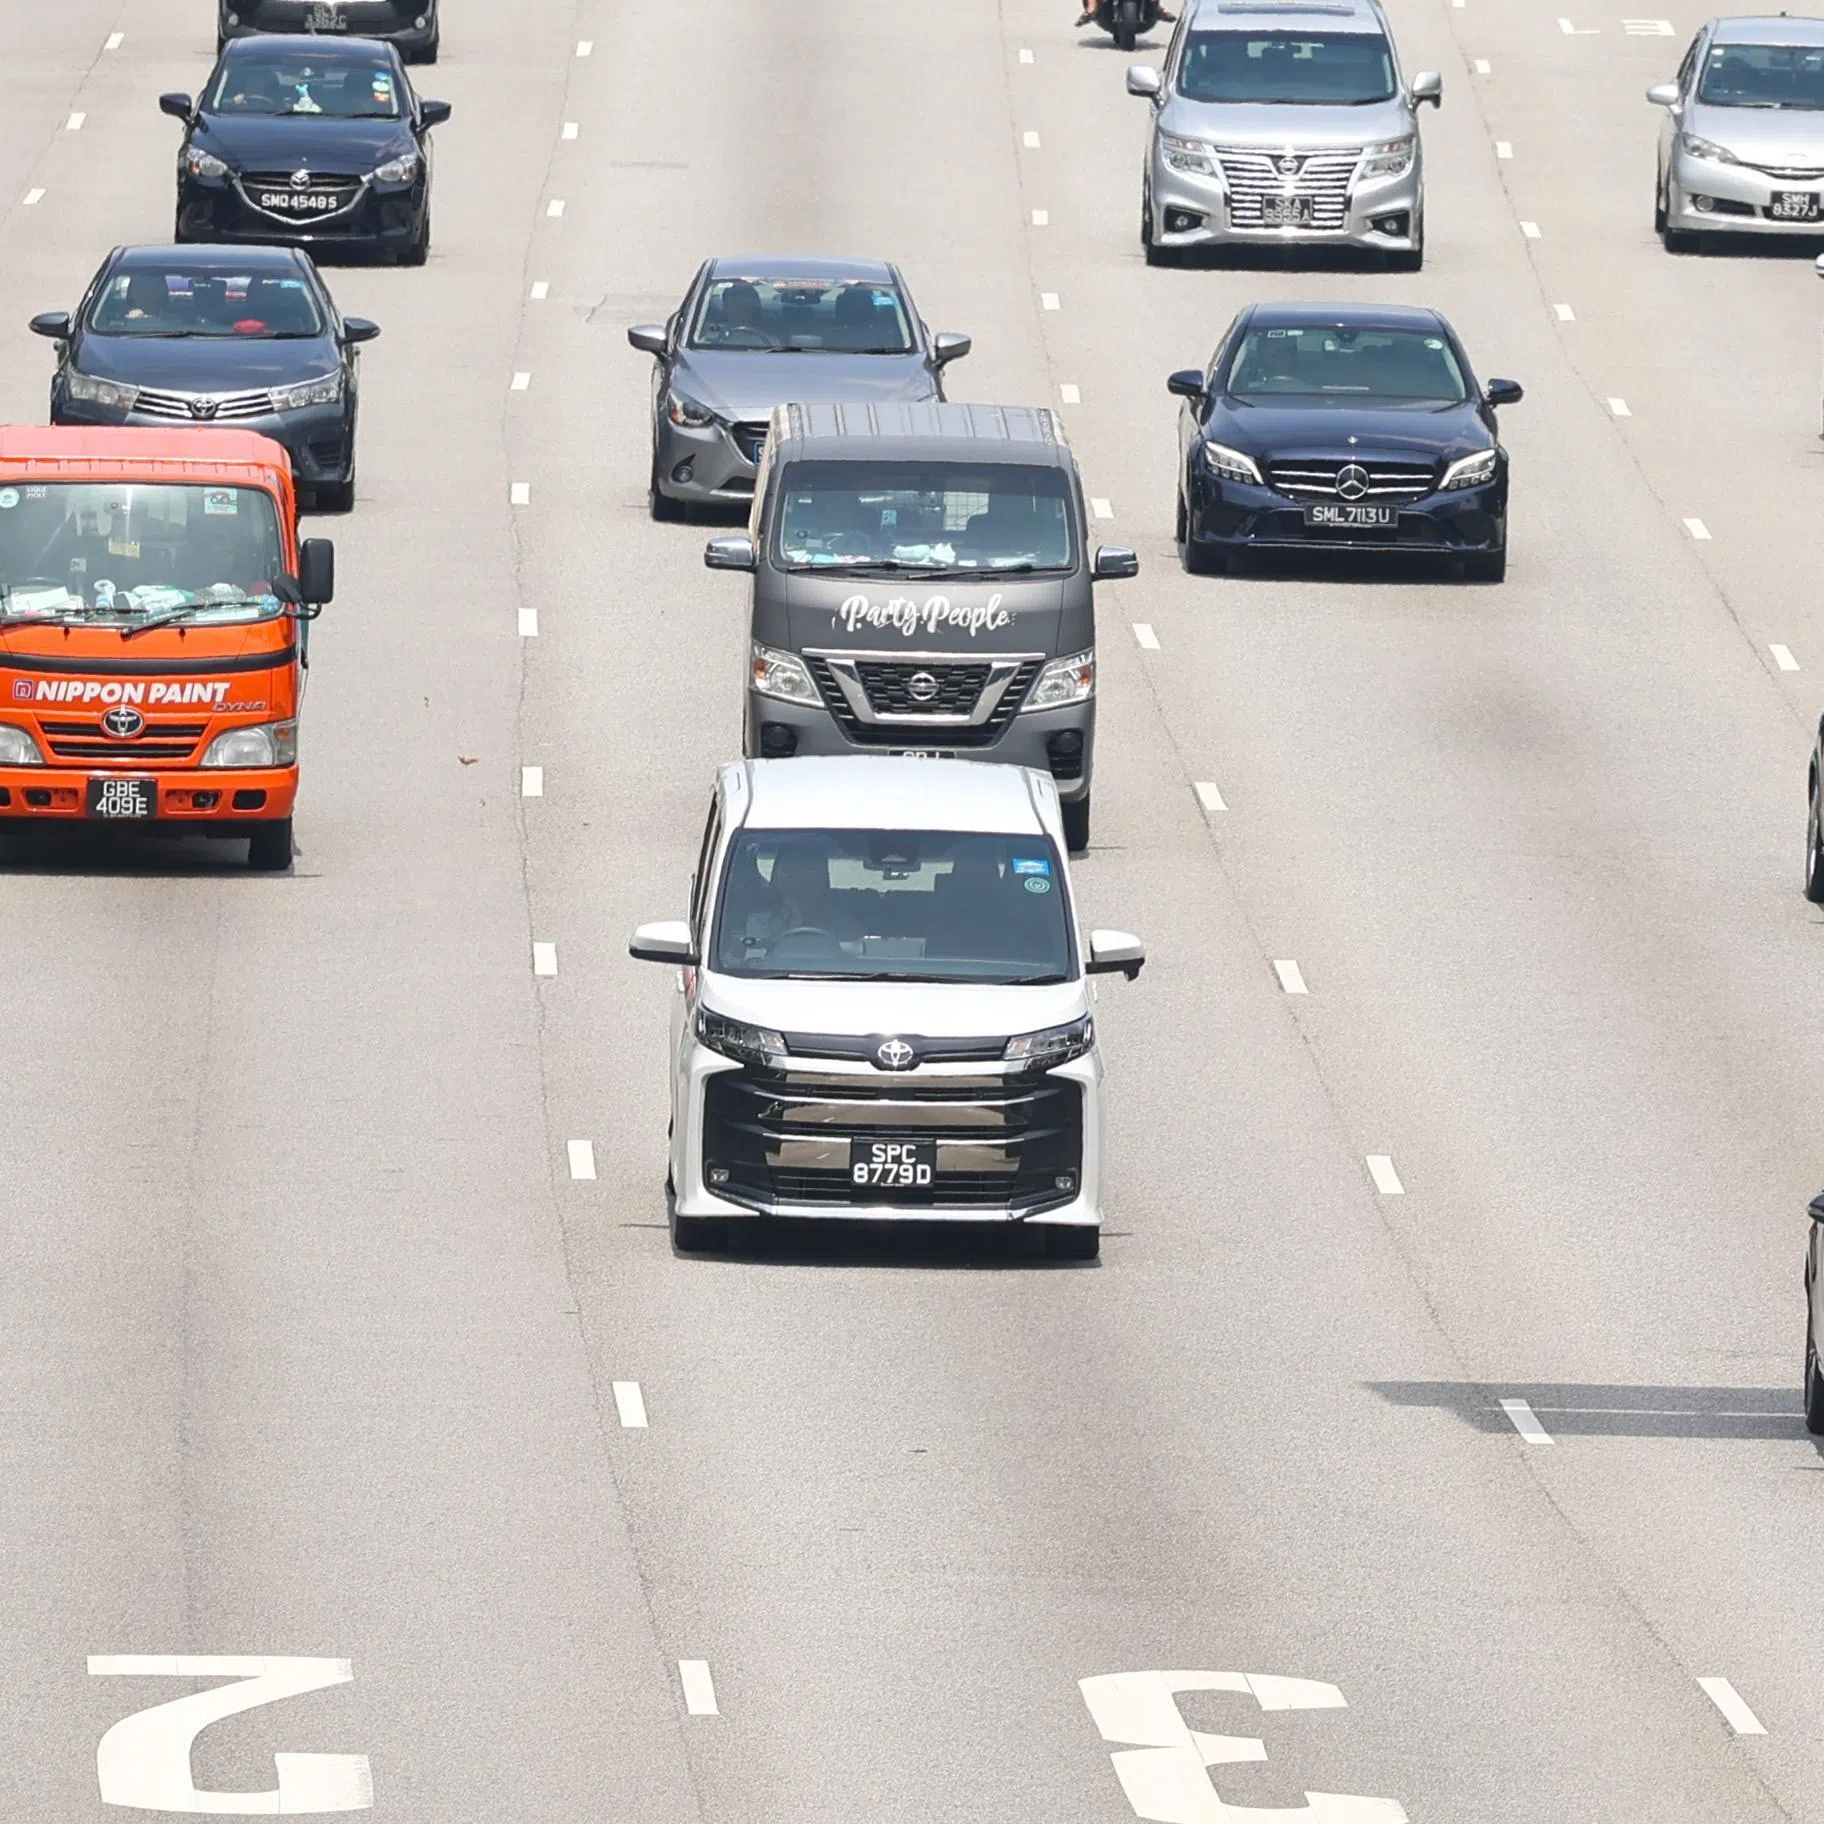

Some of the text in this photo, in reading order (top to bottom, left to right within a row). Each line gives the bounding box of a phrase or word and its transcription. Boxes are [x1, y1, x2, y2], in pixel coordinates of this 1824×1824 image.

[1781, 192, 1810, 205] SMH
[840, 592, 1010, 637] Party People
[36, 680, 231, 704] NIPPON PAINT
[212, 701, 267, 712] DYNA
[102, 781, 141, 798] GBE
[95, 797, 148, 815] 409E
[871, 1144, 917, 1164] SPC
[853, 1162, 931, 1185] 8779D
[86, 1654, 374, 1815] 2
[1078, 1669, 1410, 1824] 3
